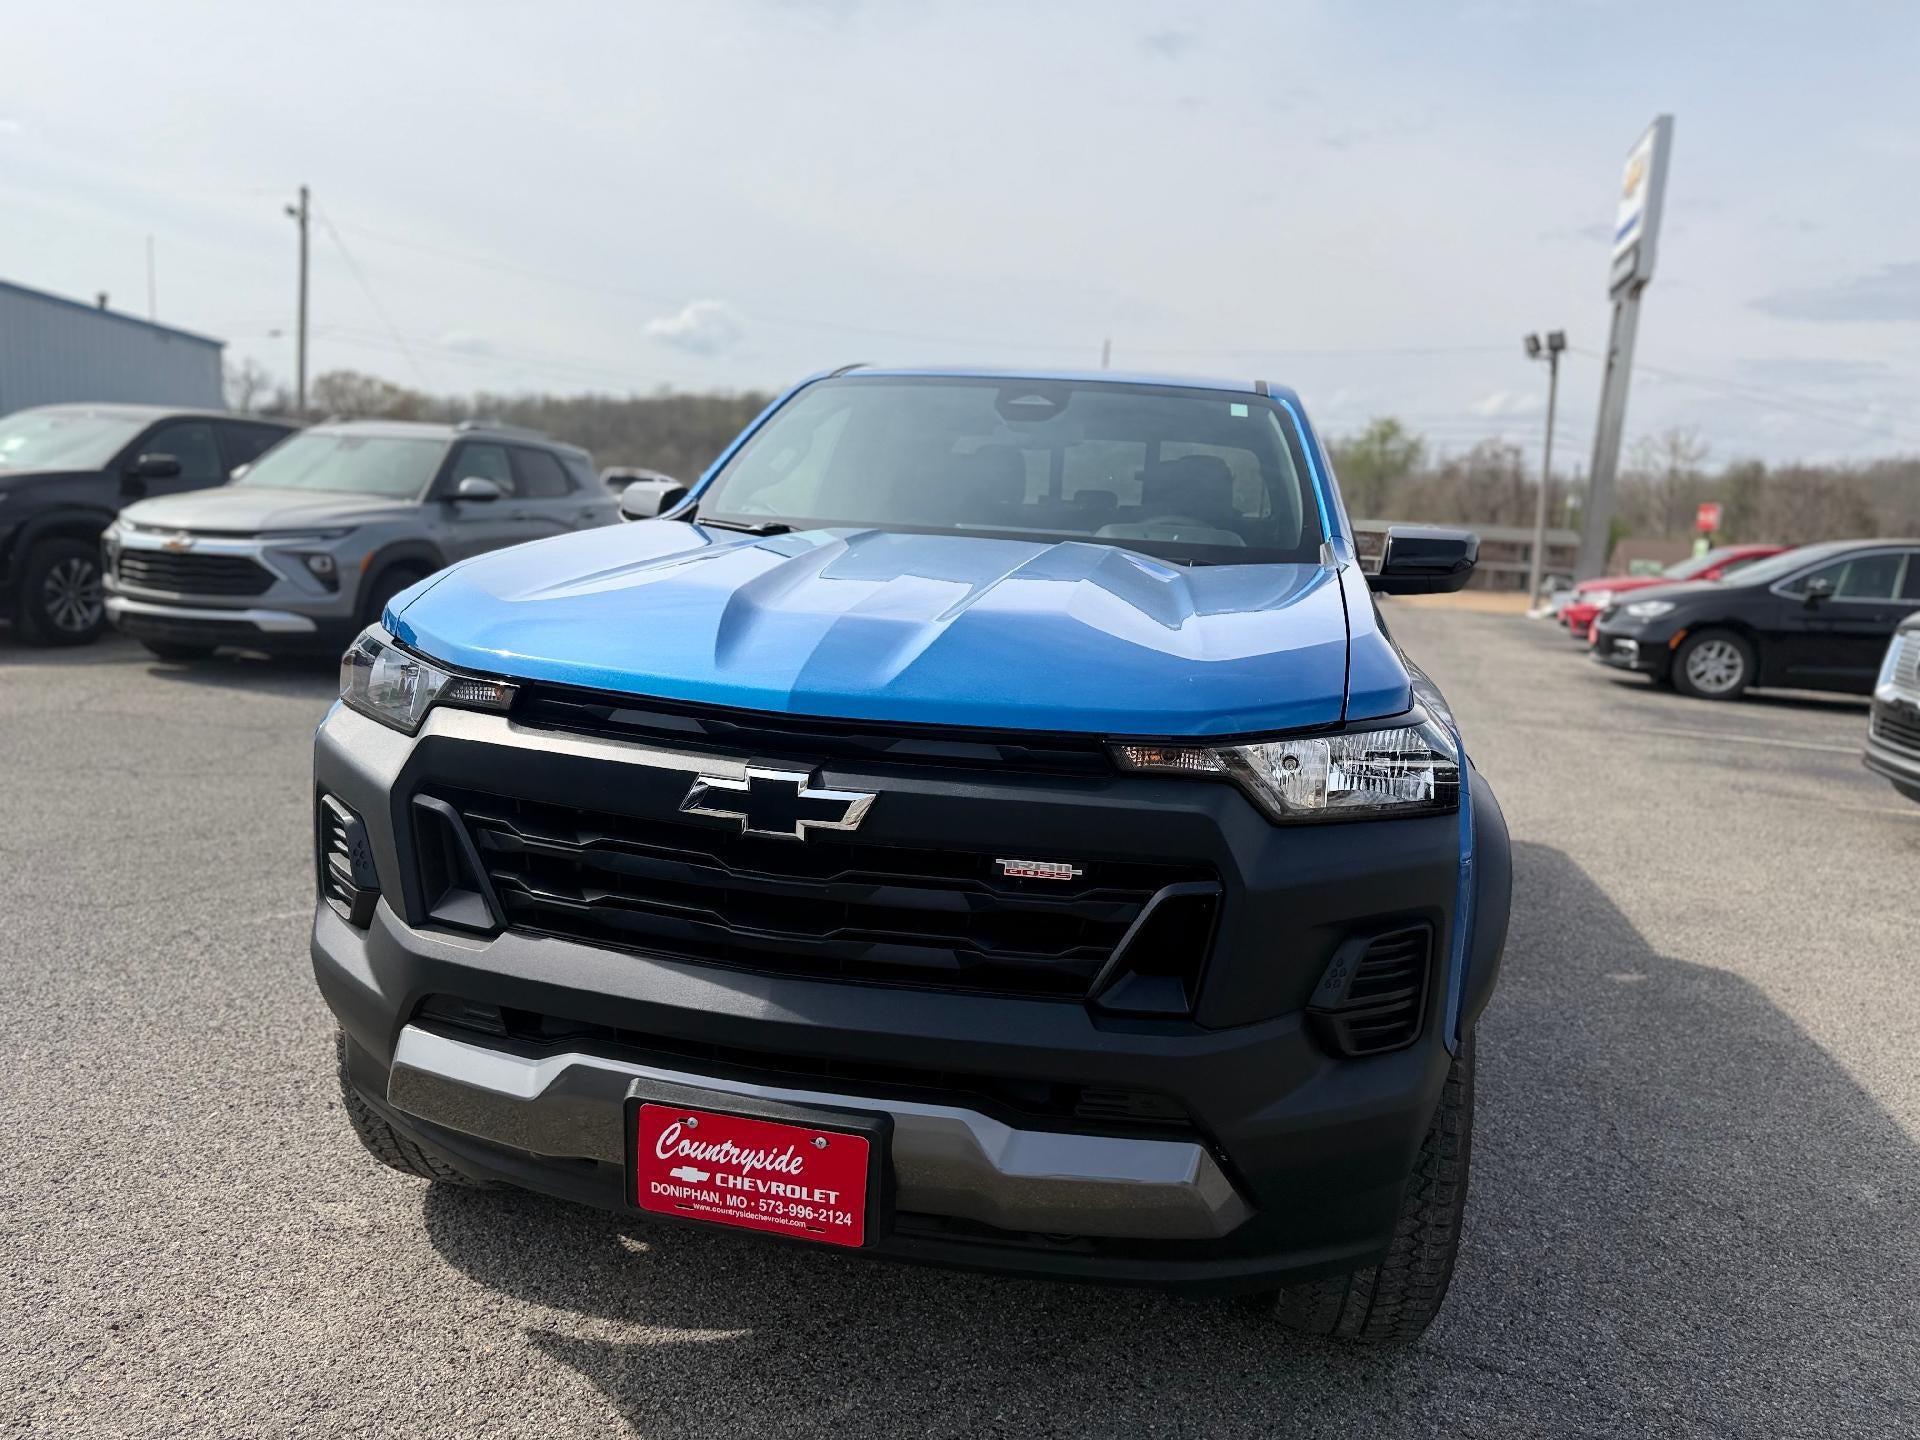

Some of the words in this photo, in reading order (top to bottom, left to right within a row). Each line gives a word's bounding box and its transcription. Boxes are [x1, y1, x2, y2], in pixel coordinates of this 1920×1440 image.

[996, 859, 1082, 875] TRAIL
[1004, 868, 1072, 880] BOSS
[655, 1122, 804, 1175] Countryside
[715, 1173, 840, 1205] CHEVROLET
[651, 1181, 722, 1206] DONIPHAN,
[726, 1194, 747, 1209] MO
[758, 1198, 853, 1227] 573-996-2124
[693, 1203, 806, 1228] www.countrysidechevrolet.com
